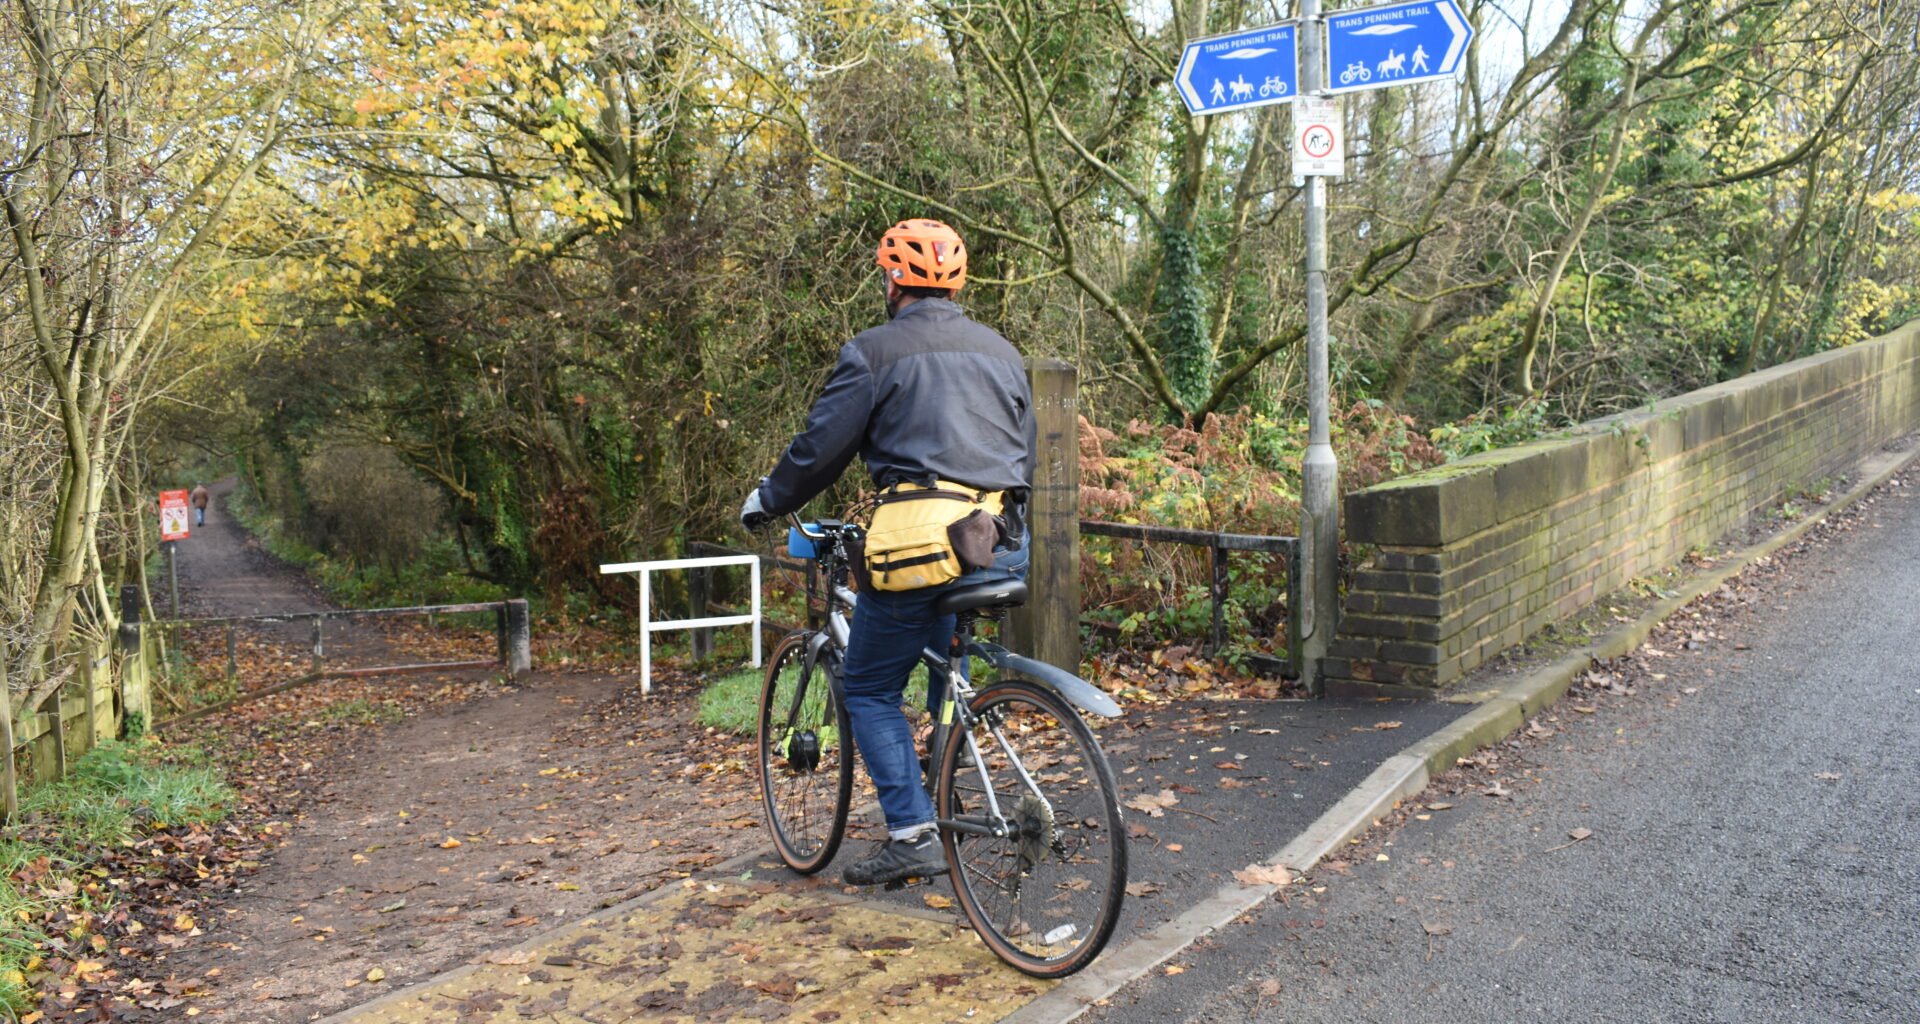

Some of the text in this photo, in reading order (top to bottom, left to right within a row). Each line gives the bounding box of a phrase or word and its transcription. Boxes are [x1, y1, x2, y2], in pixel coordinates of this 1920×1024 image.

[1335, 6, 1430, 28] TRANS PENNINE TRAIL
[1205, 31, 1288, 53] TRANS PENNINE TRAIL
